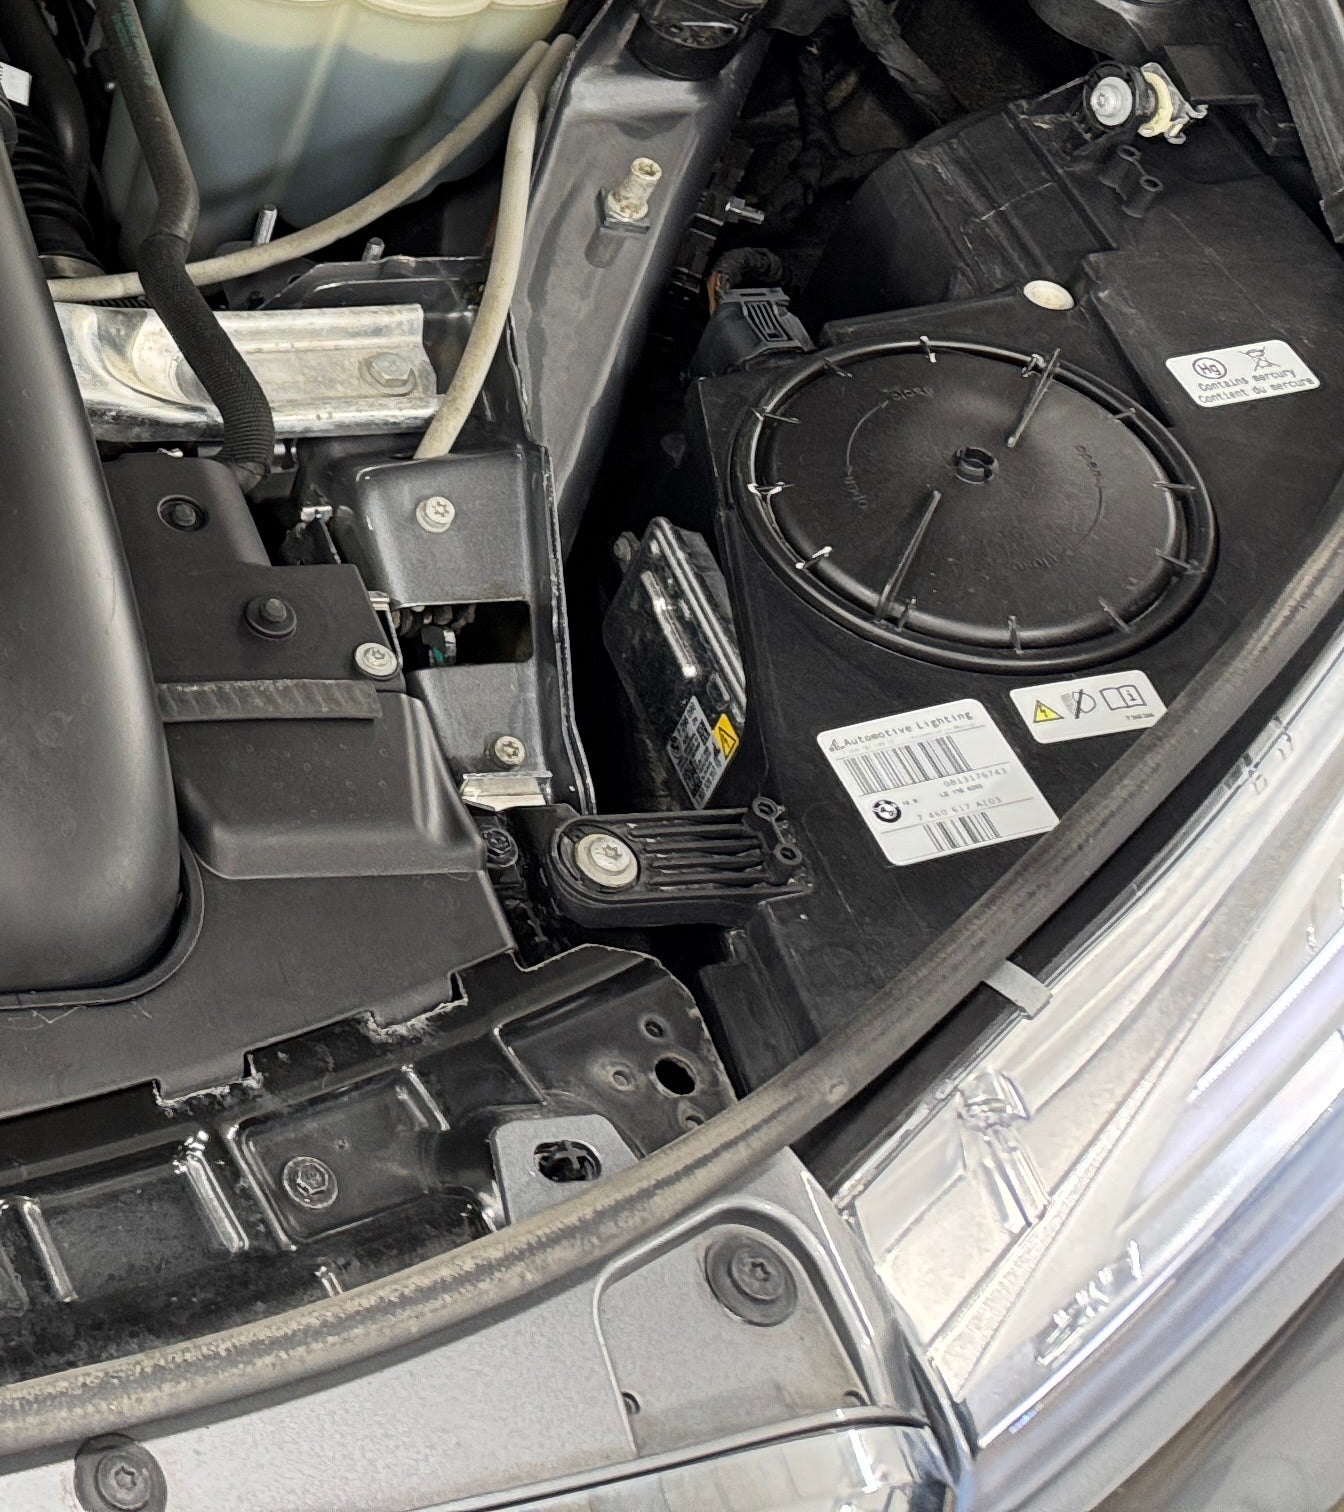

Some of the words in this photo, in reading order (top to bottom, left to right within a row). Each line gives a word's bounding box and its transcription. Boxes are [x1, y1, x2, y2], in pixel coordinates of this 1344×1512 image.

[1197, 362, 1222, 377] Hg
[1198, 376, 1249, 392] Contains
[1252, 369, 1297, 383] mercury
[1197, 389, 1248, 404] Contient
[1252, 385, 1268, 395] du
[1269, 377, 1315, 389] mercure
[843, 724, 912, 747] Automotive
[915, 710, 974, 730] Lighting
